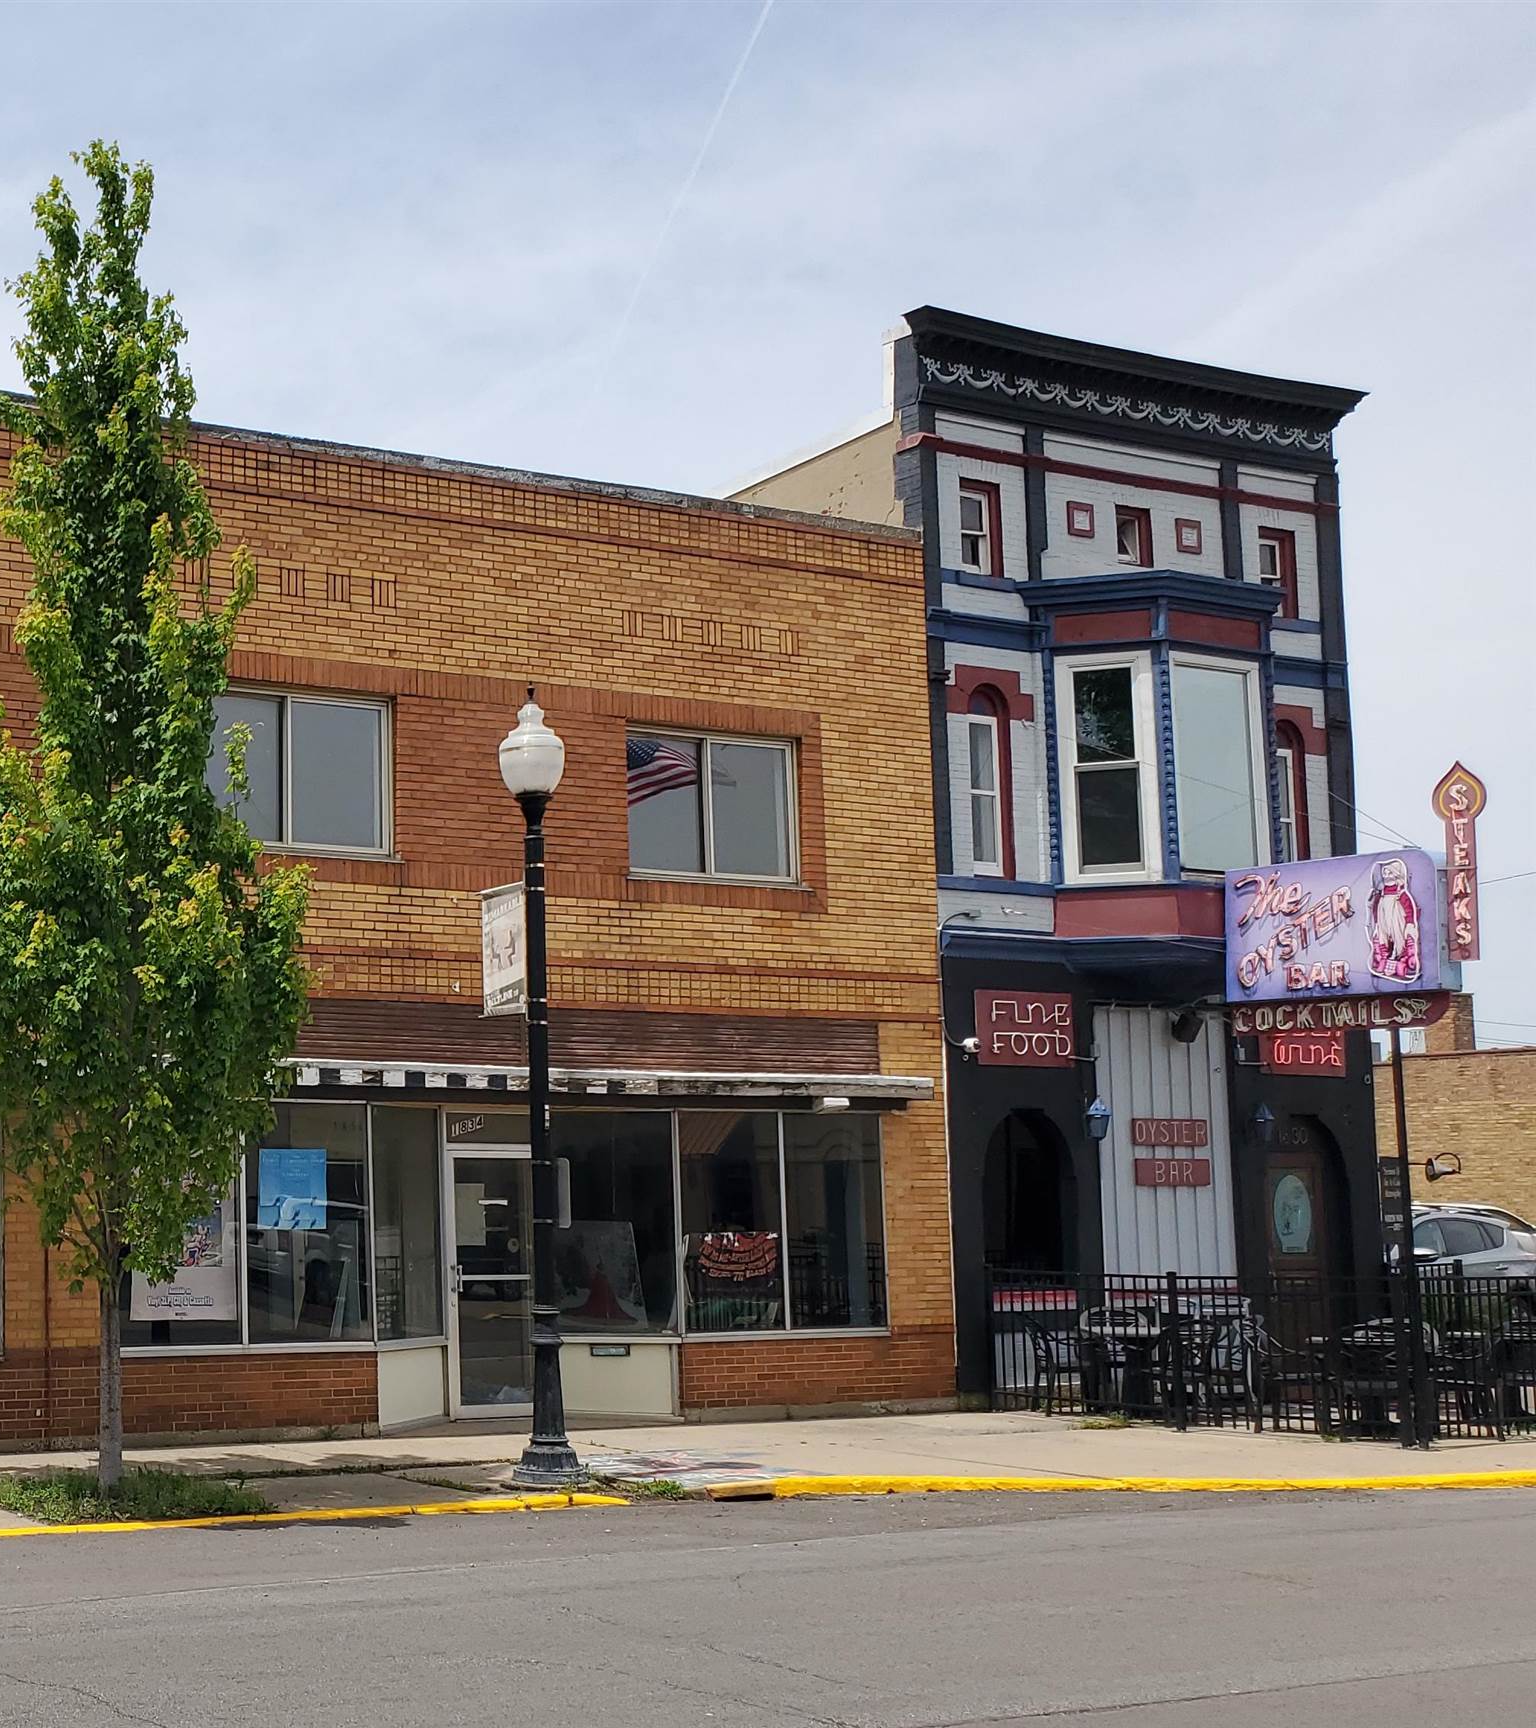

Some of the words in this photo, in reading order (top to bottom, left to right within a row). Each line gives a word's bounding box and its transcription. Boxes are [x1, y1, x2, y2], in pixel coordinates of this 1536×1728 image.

[1449, 784, 1472, 945] STEAKS
[1234, 871, 1311, 927] The
[1238, 886, 1355, 989] OYSTER
[1286, 960, 1351, 991] BAR
[1234, 998, 1412, 1031] COCKTAILS
[992, 1029, 1071, 1056] FOOD
[451, 1114, 484, 1137] 1834
[1135, 1120, 1206, 1143] OYSTER
[1154, 1161, 1193, 1183] BAR
